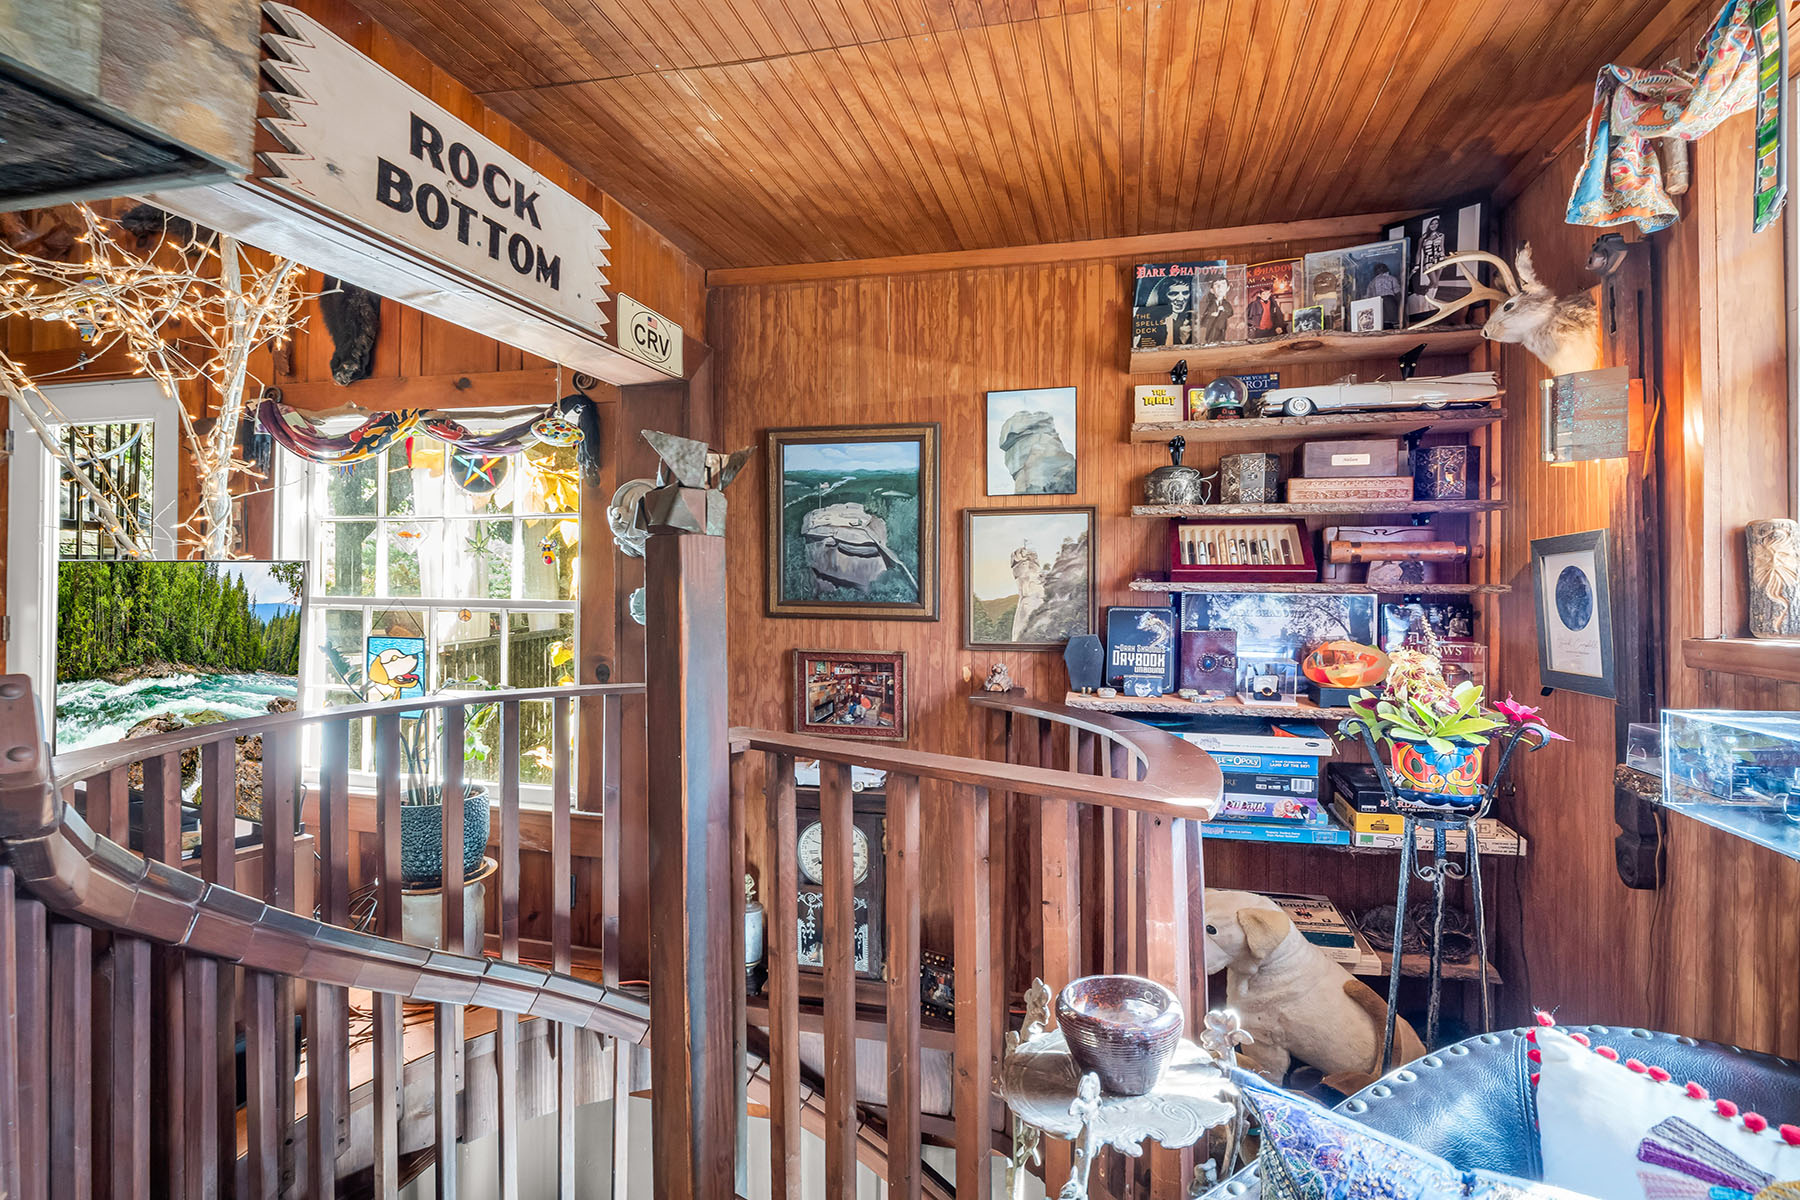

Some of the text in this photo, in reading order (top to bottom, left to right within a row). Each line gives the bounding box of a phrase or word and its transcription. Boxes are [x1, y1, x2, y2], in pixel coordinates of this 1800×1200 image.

[409, 111, 542, 230] ROCK
[376, 157, 562, 291] BOTTOM
[1136, 264, 1224, 279] DARK SHADOWS
[1135, 319, 1165, 328] SPELLS
[1135, 327, 1158, 335] DECK
[634, 323, 670, 357] CRV
[1245, 379, 1271, 389] ROT
[1142, 396, 1176, 406] TAROT
[1112, 650, 1166, 667] DAYBOOK
